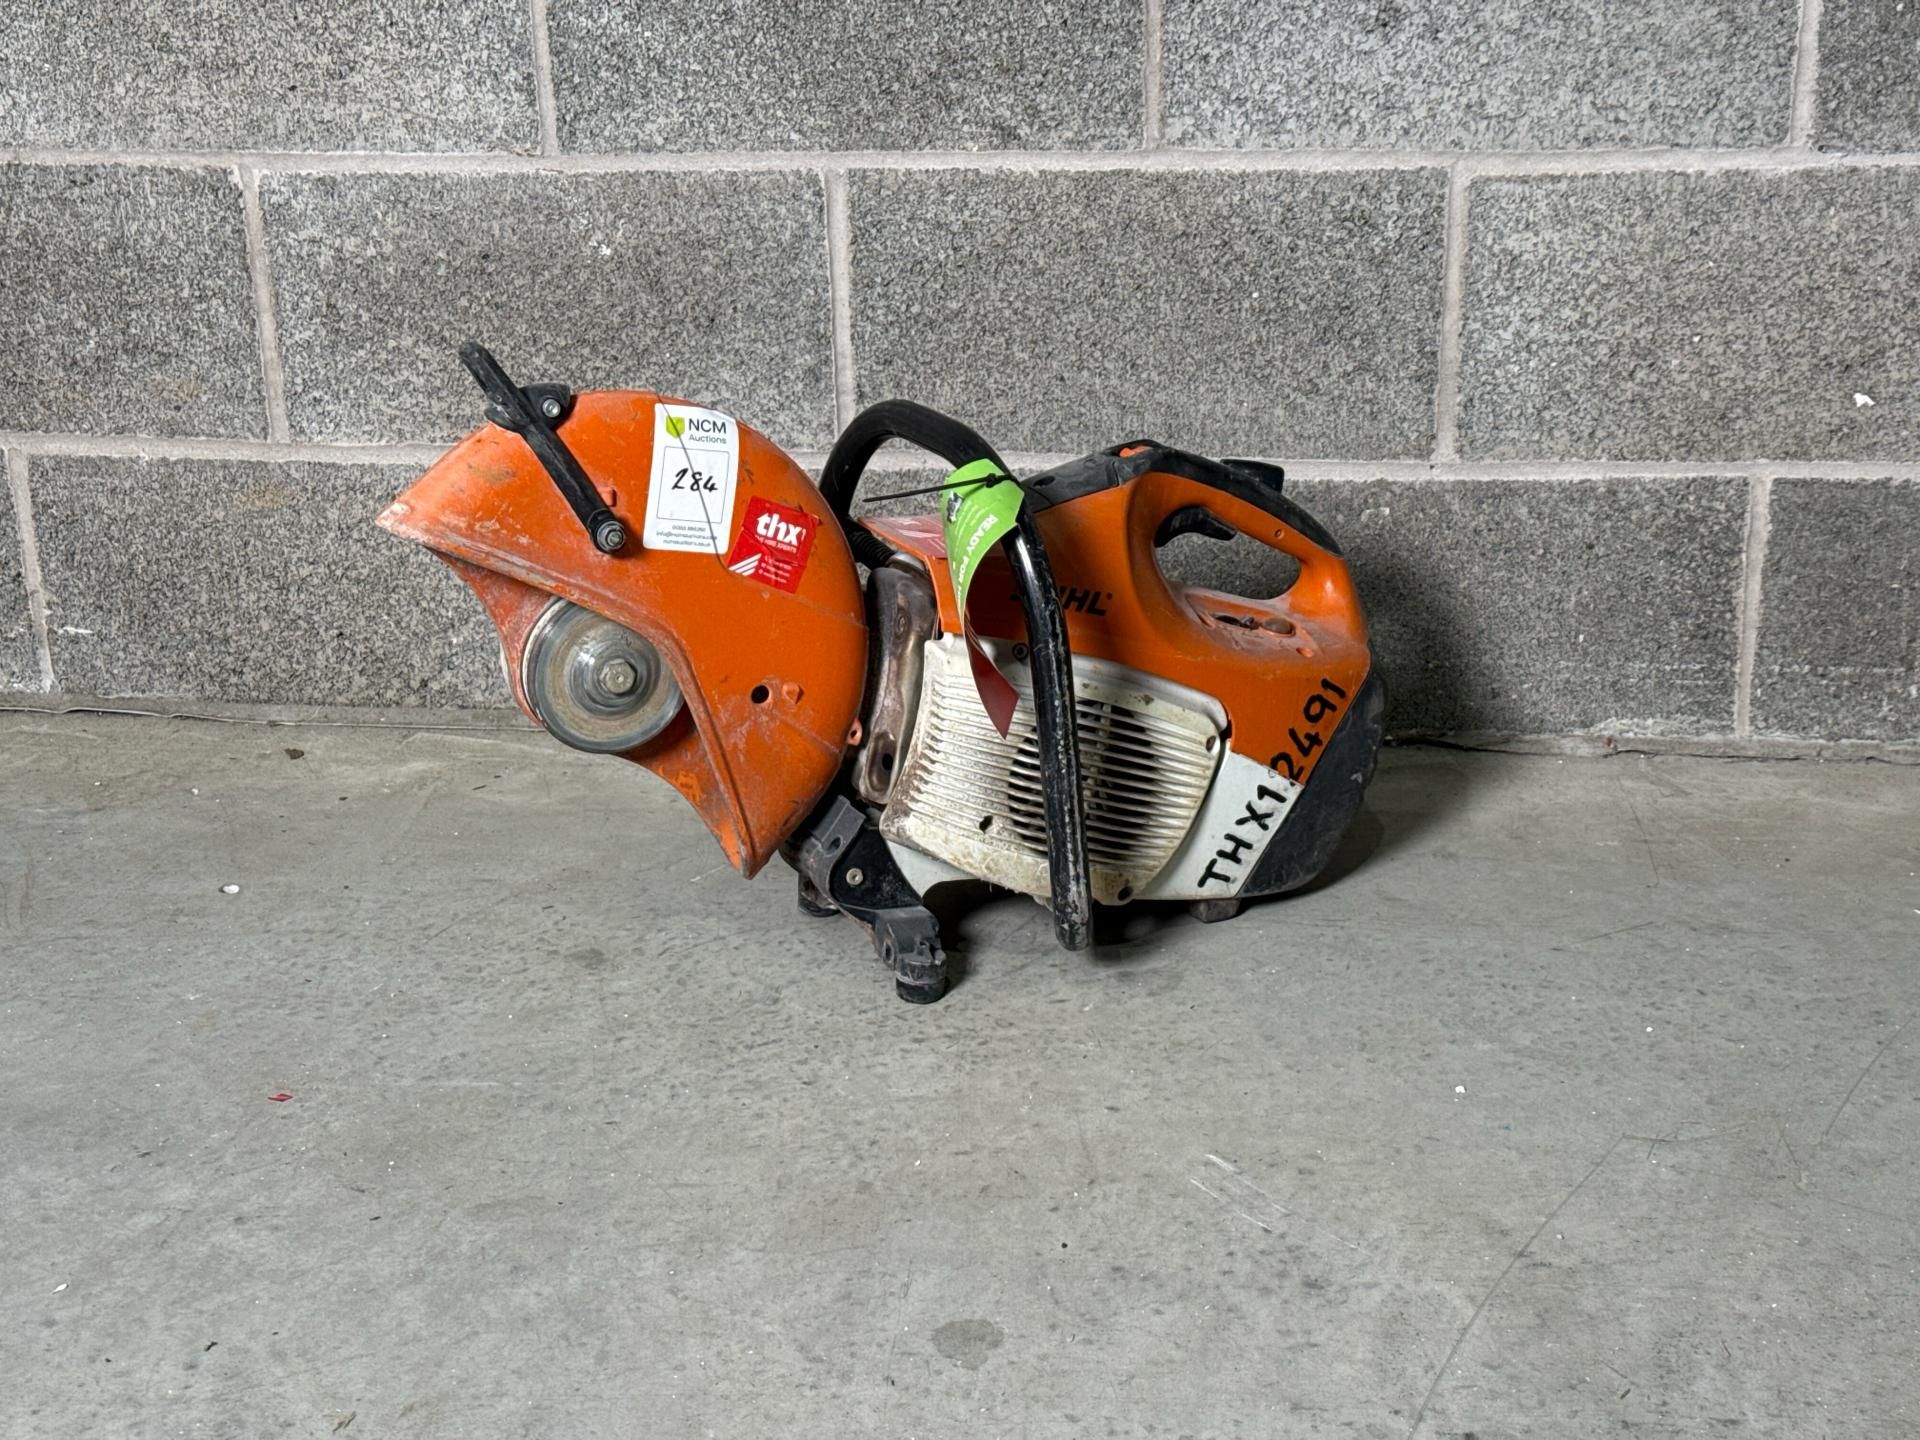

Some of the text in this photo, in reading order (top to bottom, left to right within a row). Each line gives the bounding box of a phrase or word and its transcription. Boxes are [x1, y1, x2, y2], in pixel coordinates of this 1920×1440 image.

[688, 418, 727, 434] NCM
[688, 434, 727, 445] Auctions
[672, 468, 719, 492] 284
[757, 513, 802, 547] thx
[958, 514, 998, 583] READY FOR
